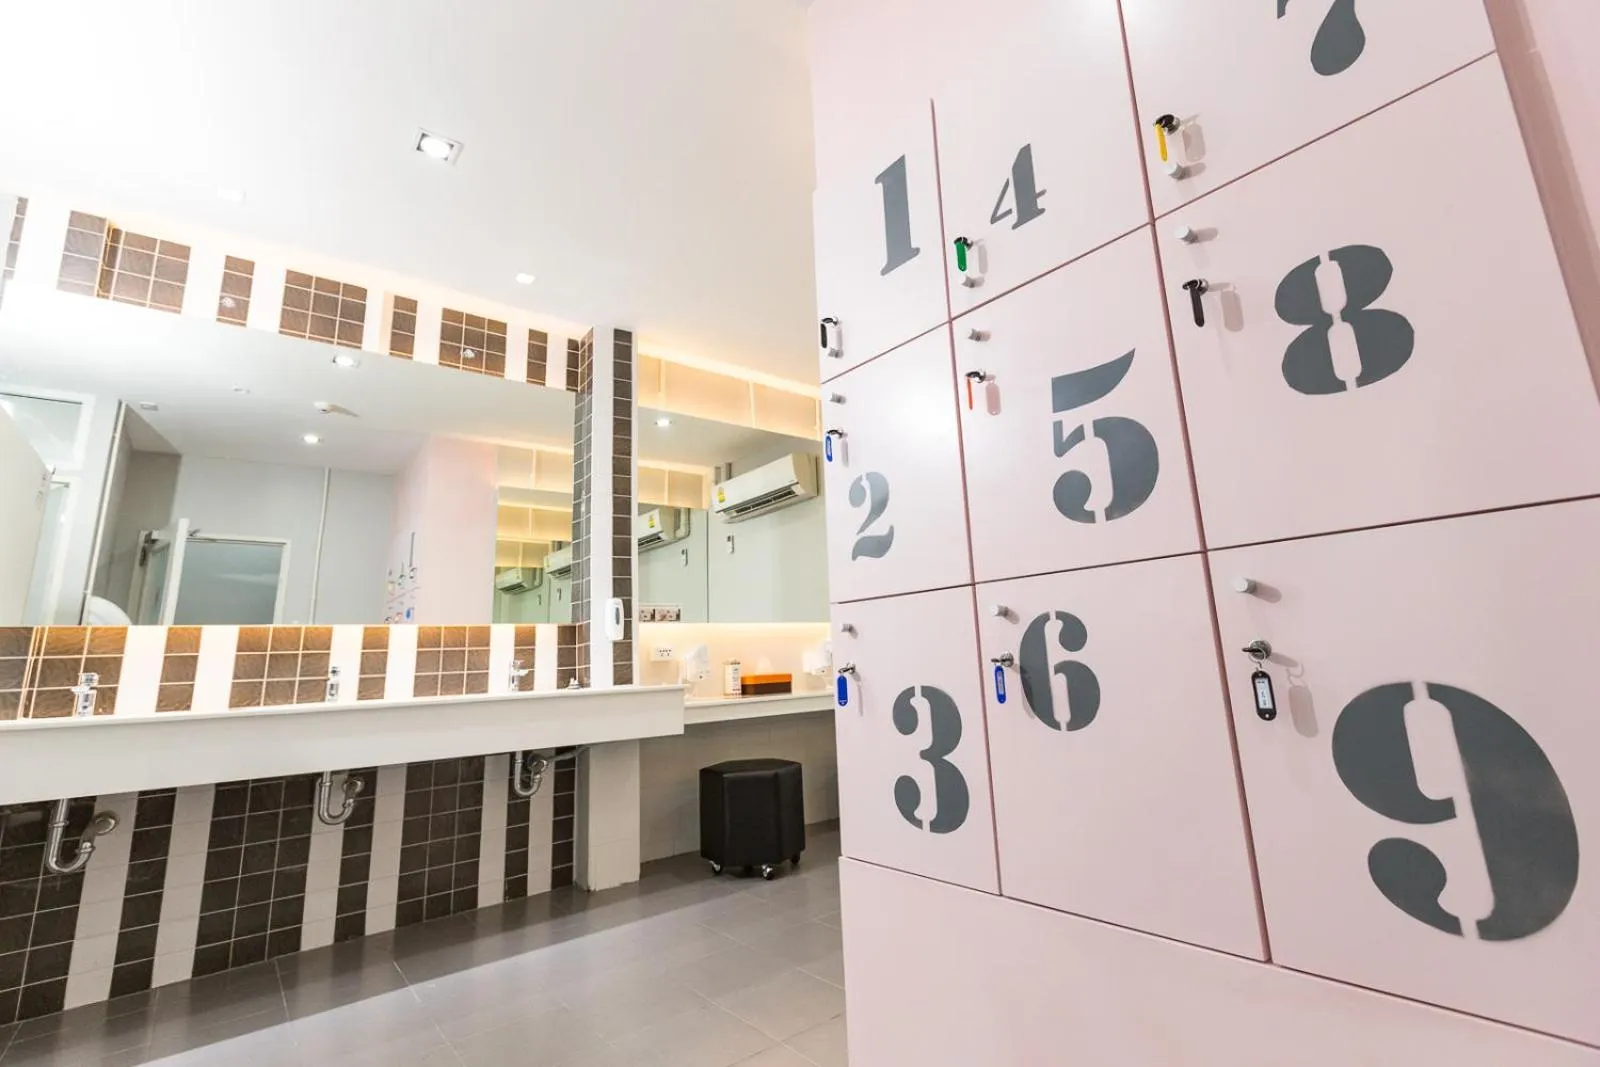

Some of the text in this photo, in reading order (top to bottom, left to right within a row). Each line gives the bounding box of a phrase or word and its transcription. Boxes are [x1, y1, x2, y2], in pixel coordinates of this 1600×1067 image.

[874, 154, 921, 276] 1
[989, 143, 1047, 230] 4
[1274, 244, 1415, 395] 8
[1051, 348, 1159, 524] 5
[848, 471, 895, 561] 2
[1018, 611, 1102, 732] 6
[892, 685, 969, 834] 3
[1332, 682, 1580, 942] 9
